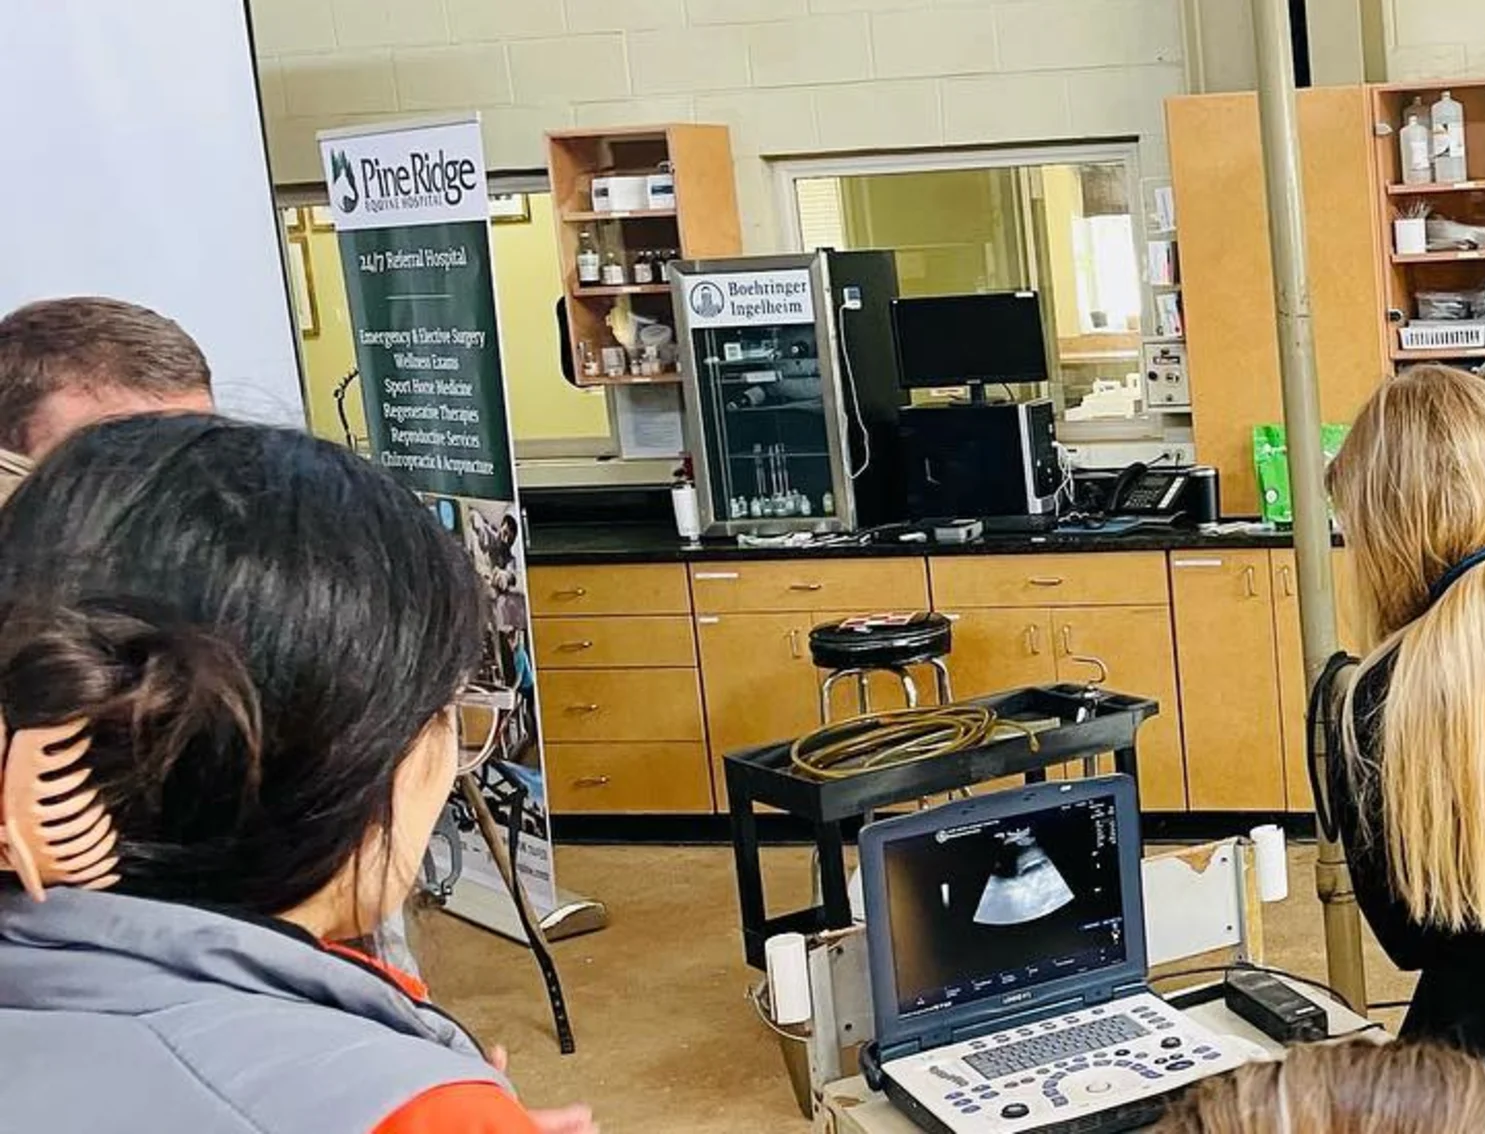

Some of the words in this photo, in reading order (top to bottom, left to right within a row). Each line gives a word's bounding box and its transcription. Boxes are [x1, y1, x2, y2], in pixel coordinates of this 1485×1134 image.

[359, 252, 385, 273] 24/7
[387, 248, 425, 270] Referral
[425, 246, 468, 271] Hospital
[728, 280, 807, 297] Boehringer
[731, 298, 803, 319] Ingelheim
[359, 329, 411, 349] Emergency
[418, 327, 450, 344] Elective
[451, 329, 485, 349] Surgery
[393, 352, 431, 369] Wellness
[432, 354, 459, 370] Exams
[384, 378, 411, 397] Sport
[435, 379, 473, 396] Medicine
[383, 402, 439, 423] Regenerative
[439, 404, 479, 425] Therapies
[391, 427, 445, 447] Reproductive
[446, 430, 480, 448] Services
[381, 450, 436, 471] Chiropractic
[442, 456, 494, 475] Acupuncture
